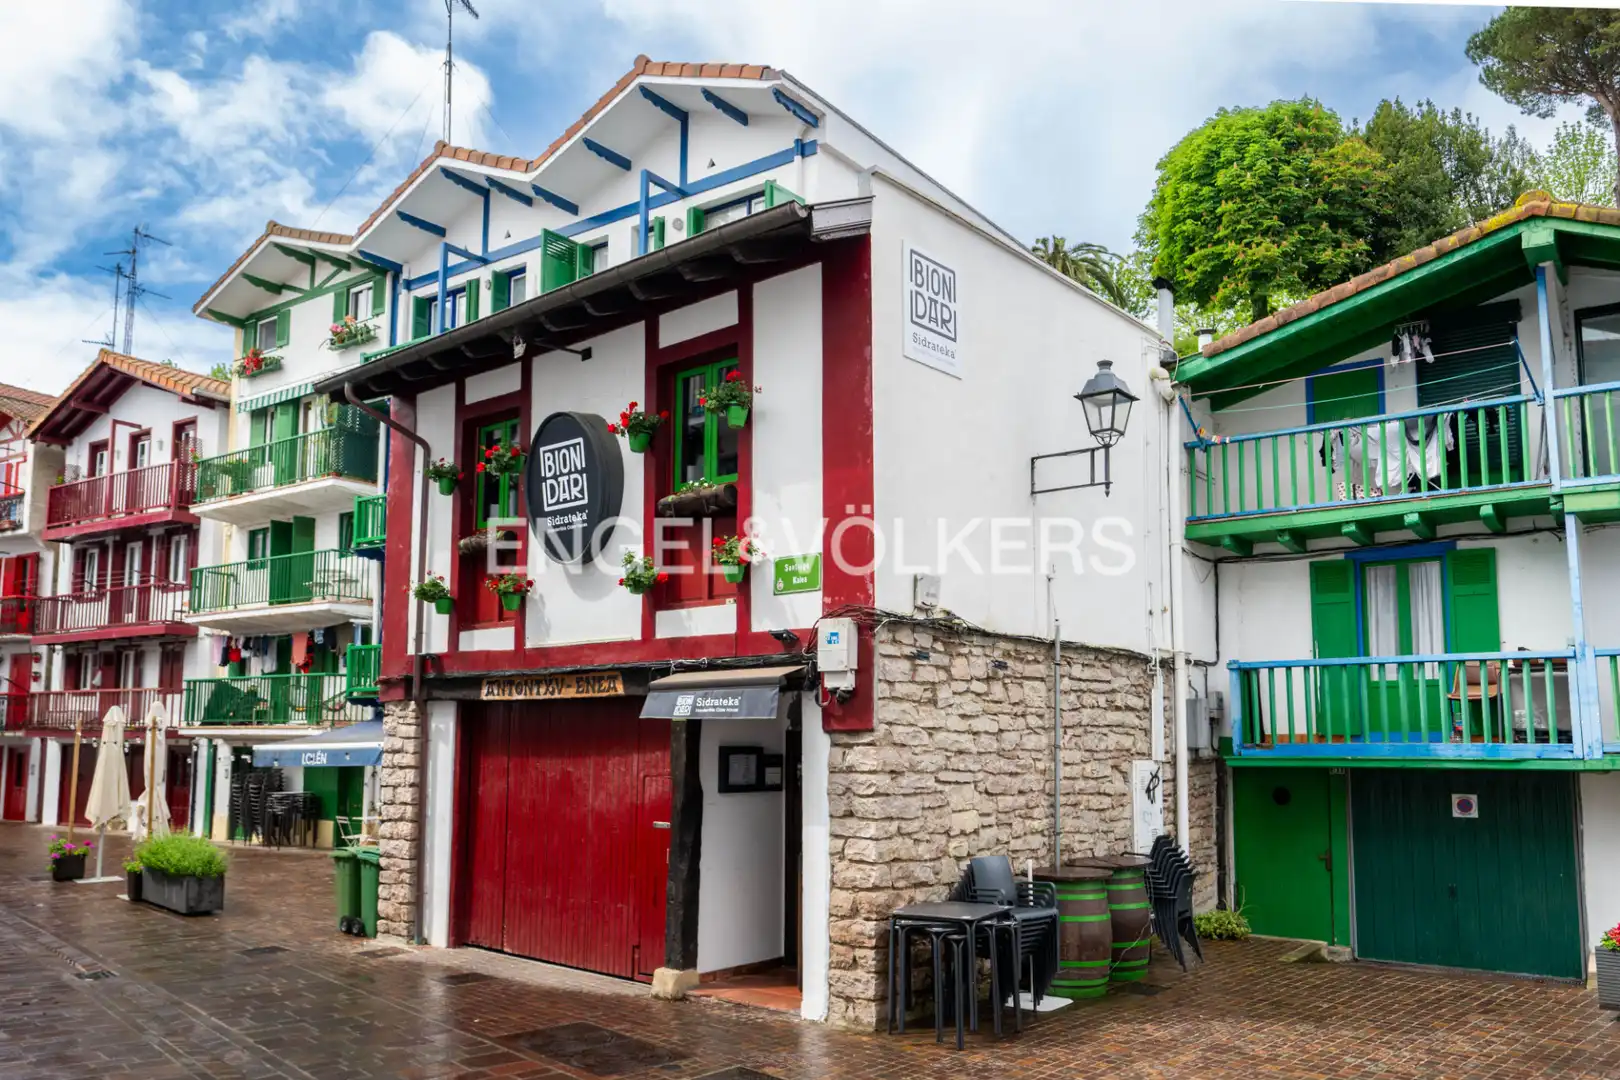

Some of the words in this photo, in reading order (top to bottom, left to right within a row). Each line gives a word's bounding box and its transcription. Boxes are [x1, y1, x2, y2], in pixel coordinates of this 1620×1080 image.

[914, 258, 952, 303] BION
[914, 289, 953, 333] DAR
[912, 331, 956, 359] Sidrateka
[544, 445, 582, 478] BION
[546, 473, 584, 505] DAR
[547, 511, 588, 527] Sidrateka
[575, 676, 619, 695] ENEA
[696, 696, 741, 707] Sidrateka
